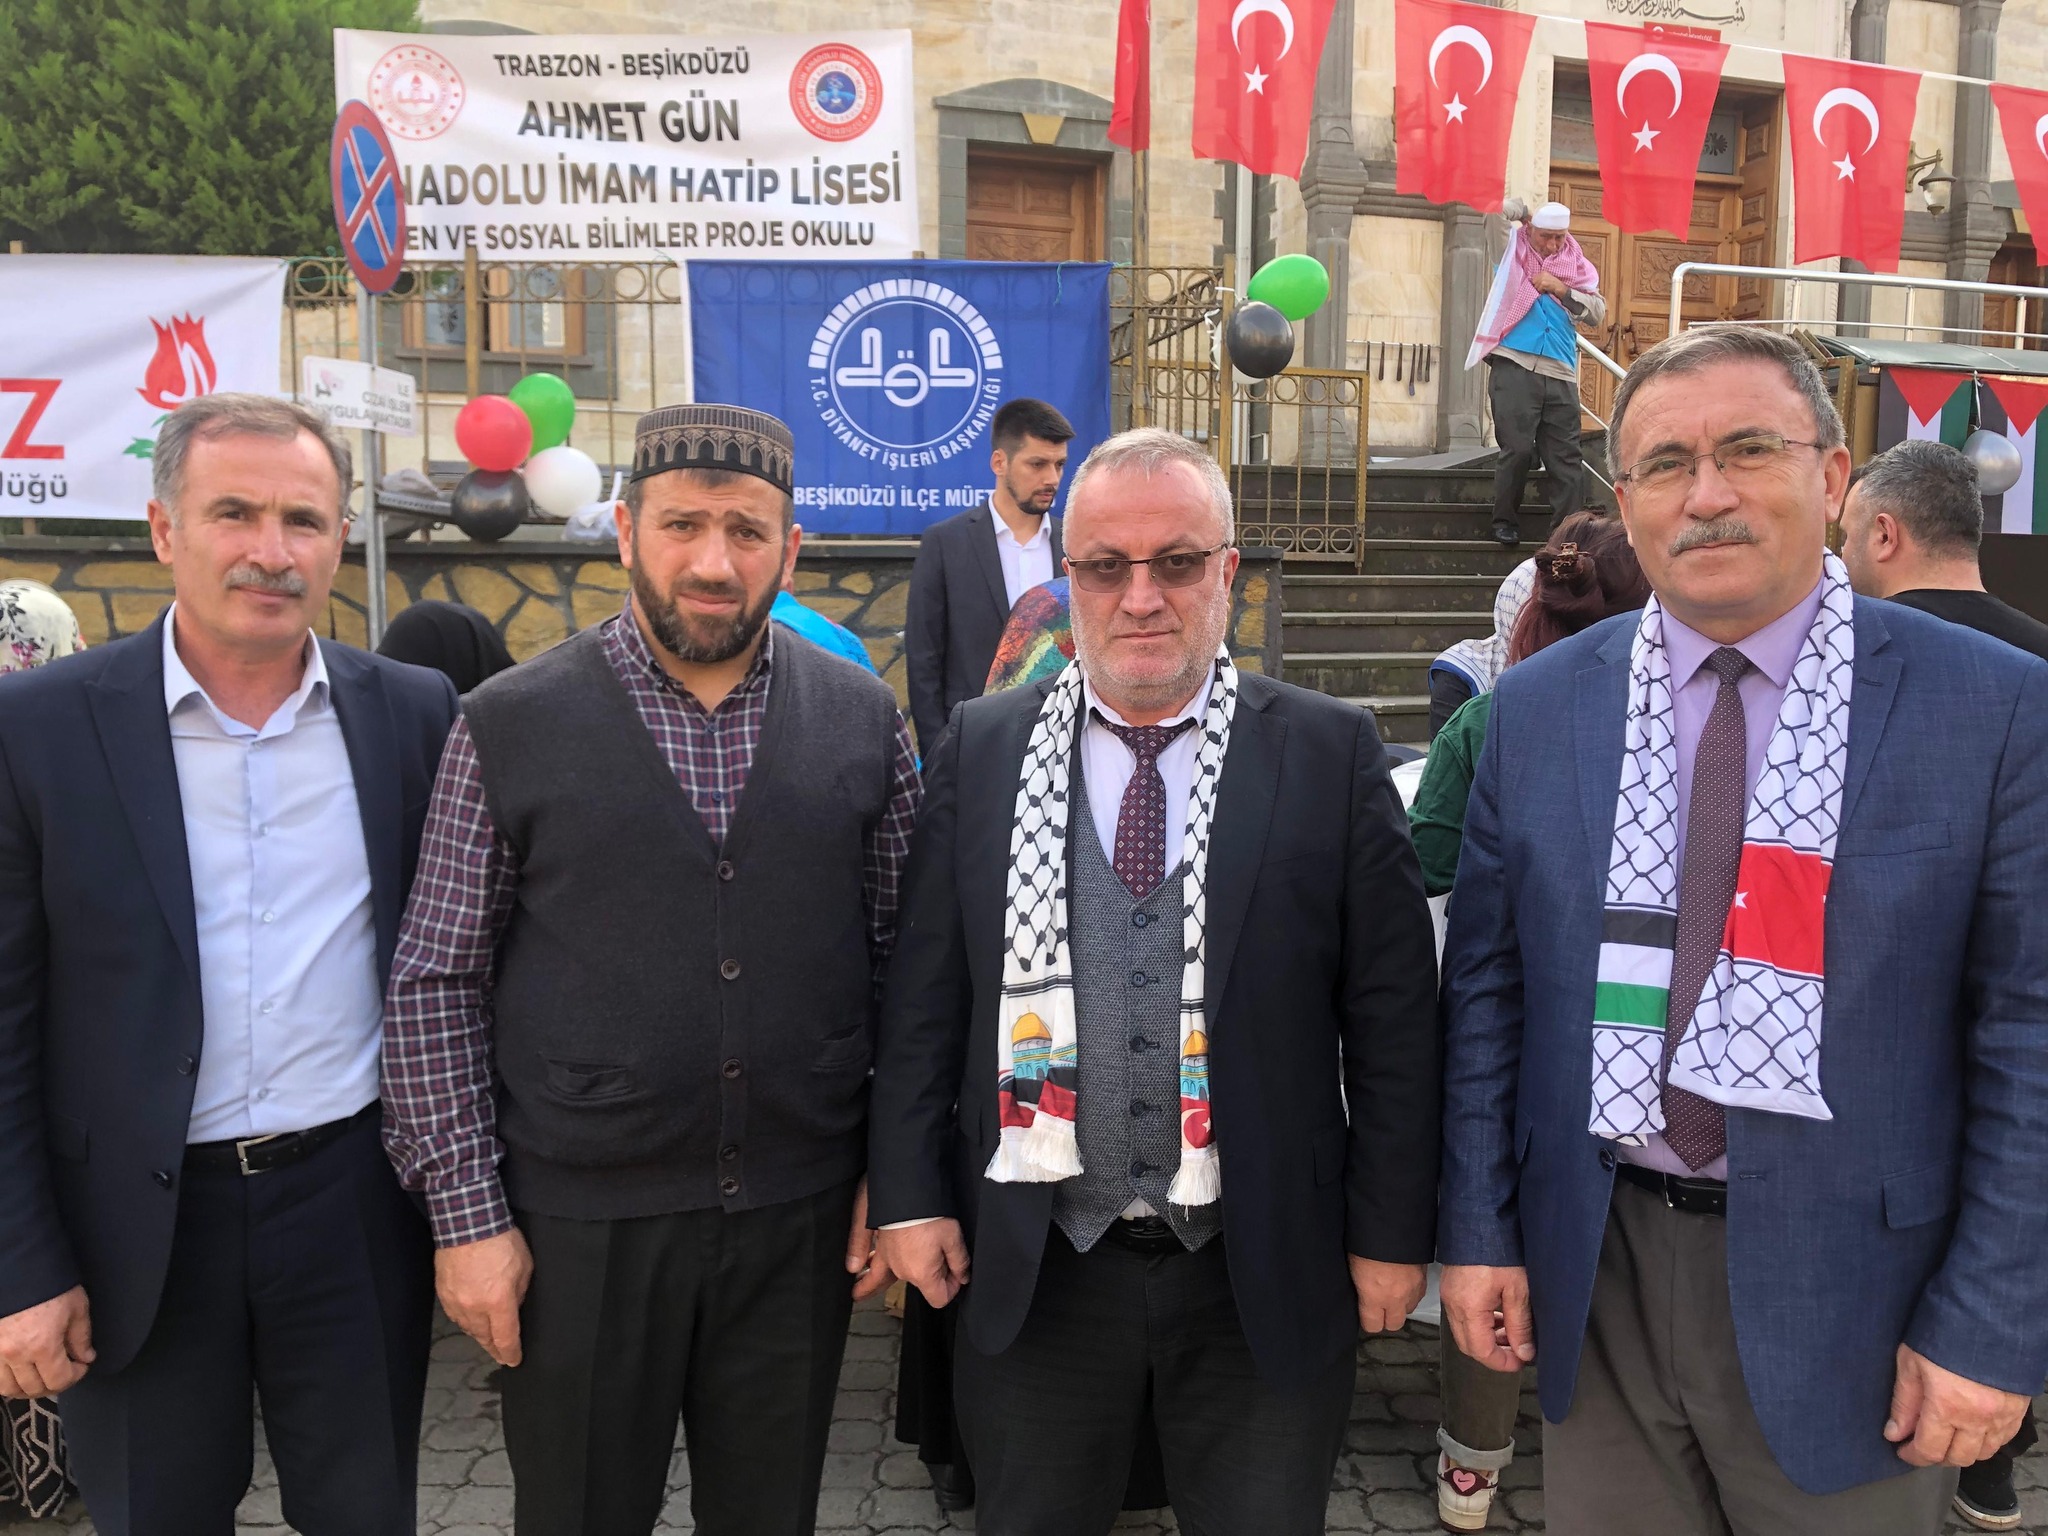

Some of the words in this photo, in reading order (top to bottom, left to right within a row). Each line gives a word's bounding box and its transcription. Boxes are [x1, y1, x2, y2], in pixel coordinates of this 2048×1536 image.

[493, 54, 601, 77] TRABZON
[622, 46, 749, 80] BEŞİKDÜZÜ
[517, 99, 646, 143] AHMET
[660, 89, 740, 142] GÜN
[558, 152, 658, 204] İMAM
[670, 158, 779, 203] HATİP
[791, 150, 902, 206] LİSESİ
[445, 225, 477, 250] VE
[485, 223, 579, 250] SOSYAL
[587, 216, 698, 249] BİLİMLER
[706, 220, 784, 248] PROJE
[791, 220, 875, 247] OKULU
[0, 378, 65, 459] Z
[810, 376, 829, 408] T.C.
[820, 408, 881, 462] DİYANET
[882, 447, 939, 471] İŞLERİ
[938, 377, 1002, 460] BAŞKANLIĞI
[793, 483, 896, 510] BEŞİKDÜZÜ
[901, 485, 940, 510] İLÇE
